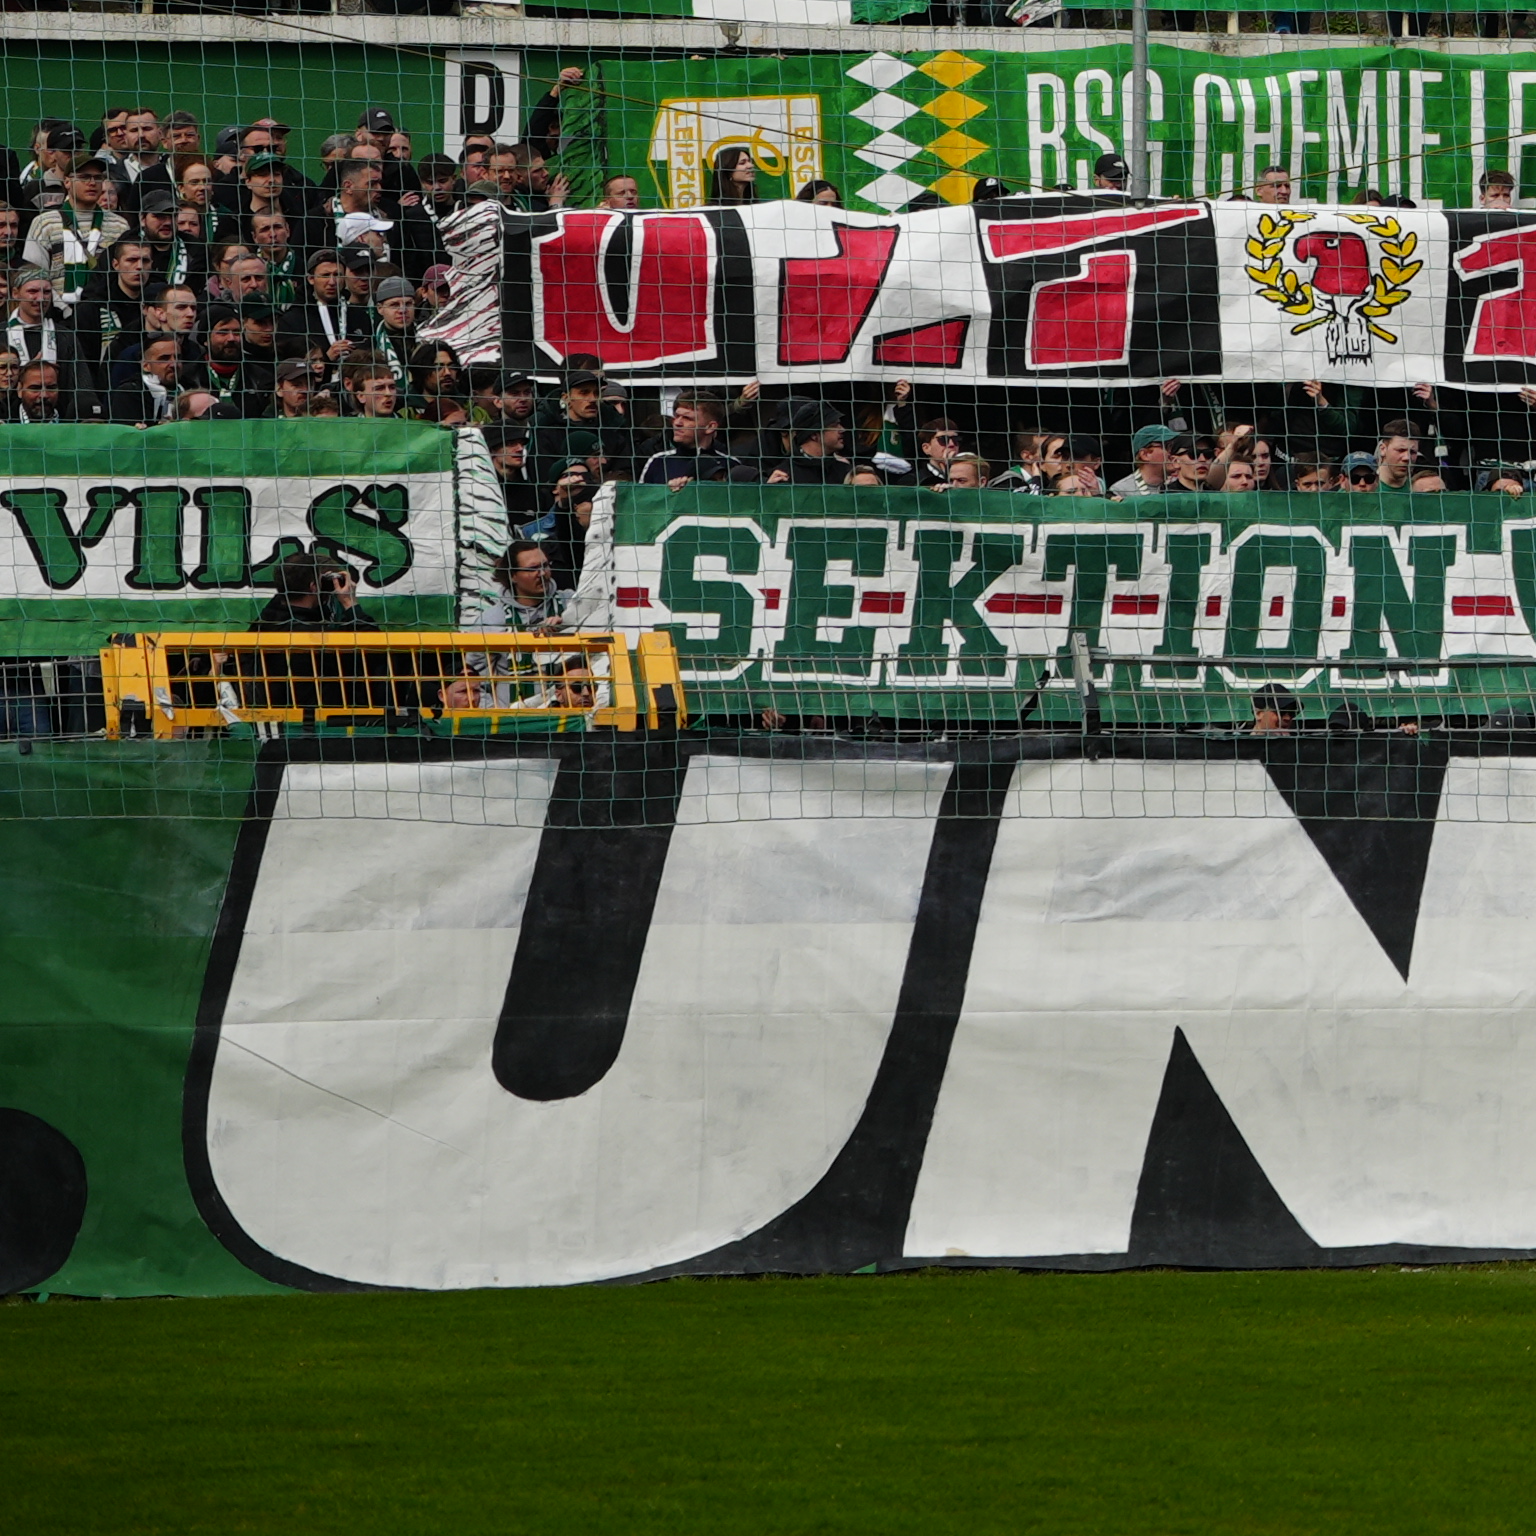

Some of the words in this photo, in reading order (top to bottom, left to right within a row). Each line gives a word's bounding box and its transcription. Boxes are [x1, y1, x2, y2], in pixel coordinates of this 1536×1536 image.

[460, 60, 506, 136] D
[1027, 68, 1165, 193] BSG
[1193, 69, 1440, 209] CHEMIE
[675, 111, 697, 208] LEIPZIG
[795, 127, 815, 184] BSG
[1, 484, 414, 591] VILS
[655, 516, 1467, 687] SEKTION
